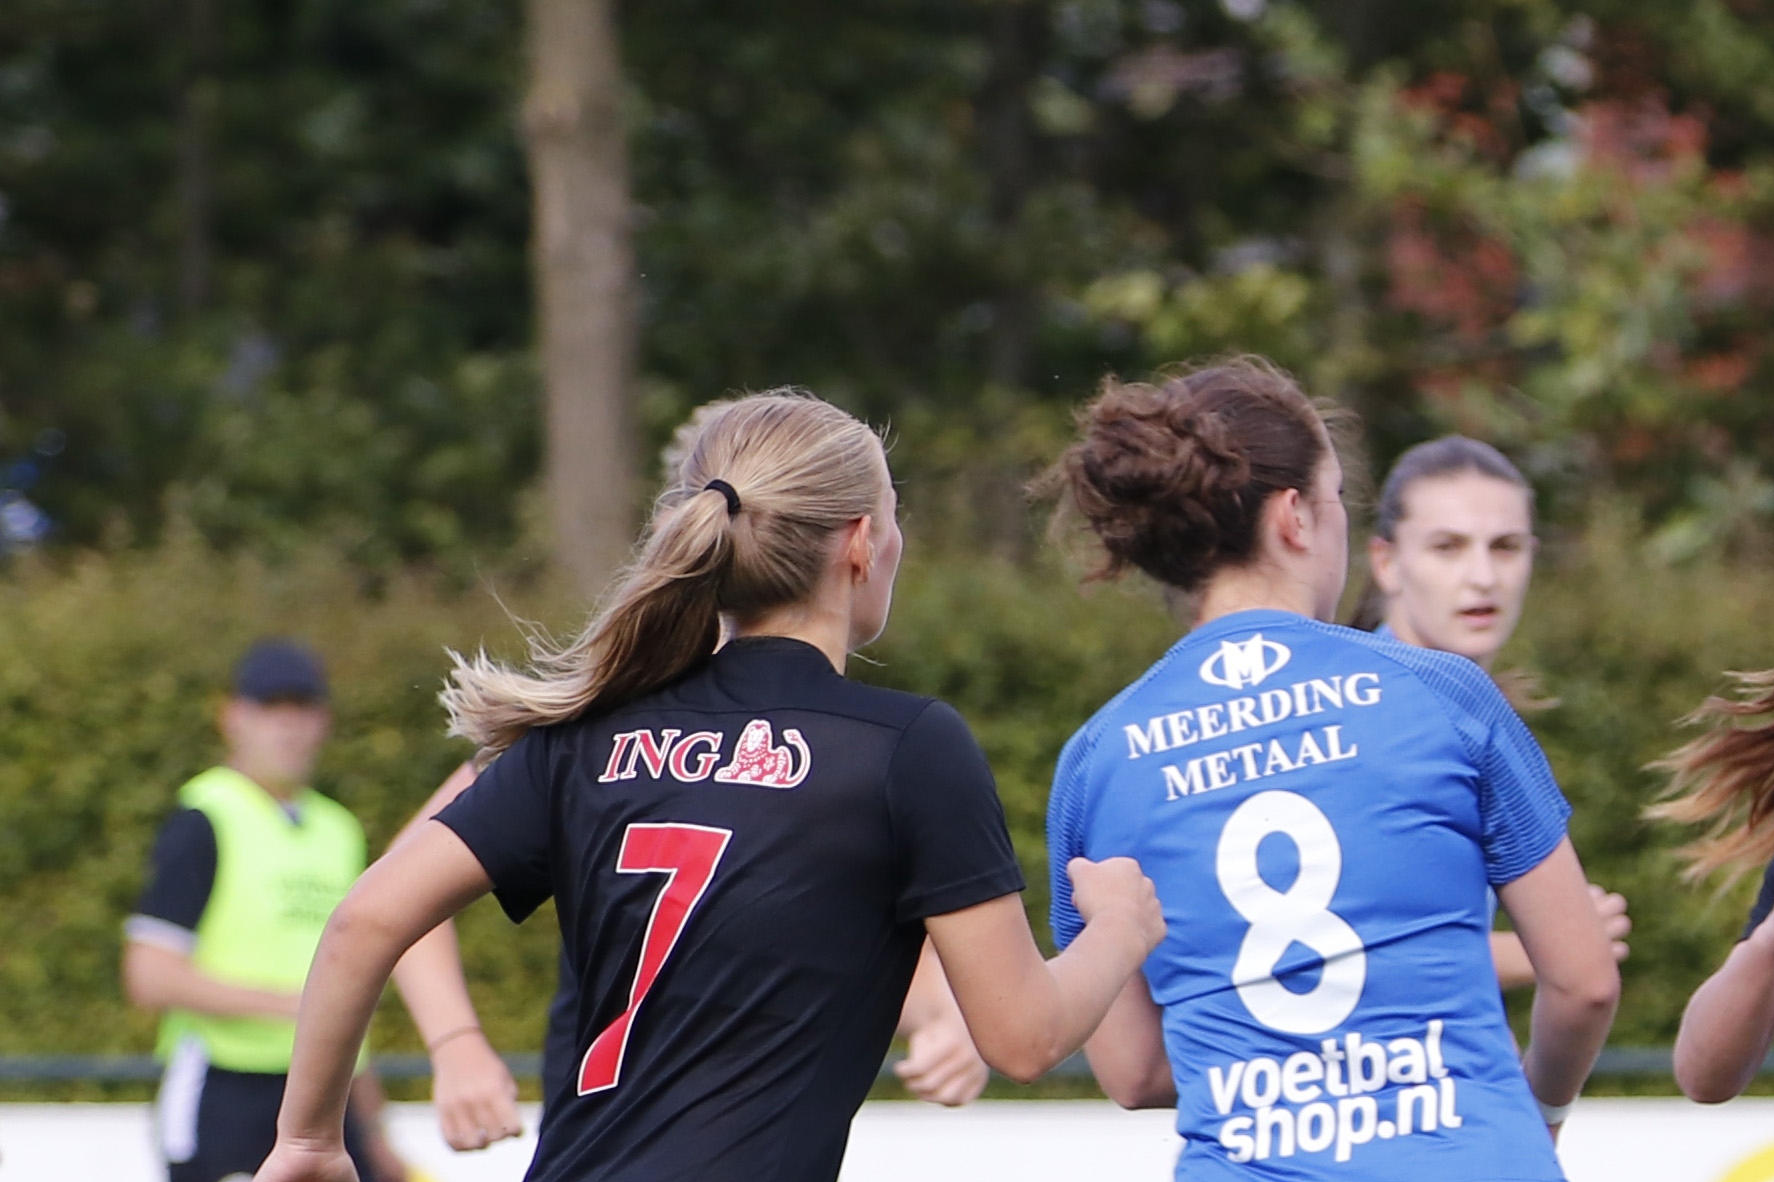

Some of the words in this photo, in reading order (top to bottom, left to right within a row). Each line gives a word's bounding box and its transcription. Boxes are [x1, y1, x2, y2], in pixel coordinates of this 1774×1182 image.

[599, 729, 723, 783] ING
[1123, 673, 1383, 760] MEERDING
[1161, 725, 1358, 801] METAAL
[1216, 790, 1367, 1035] 8
[577, 822, 734, 1096] 7
[1208, 1019, 1450, 1116] voetbal
[1219, 1077, 1463, 1163] shop.nl
